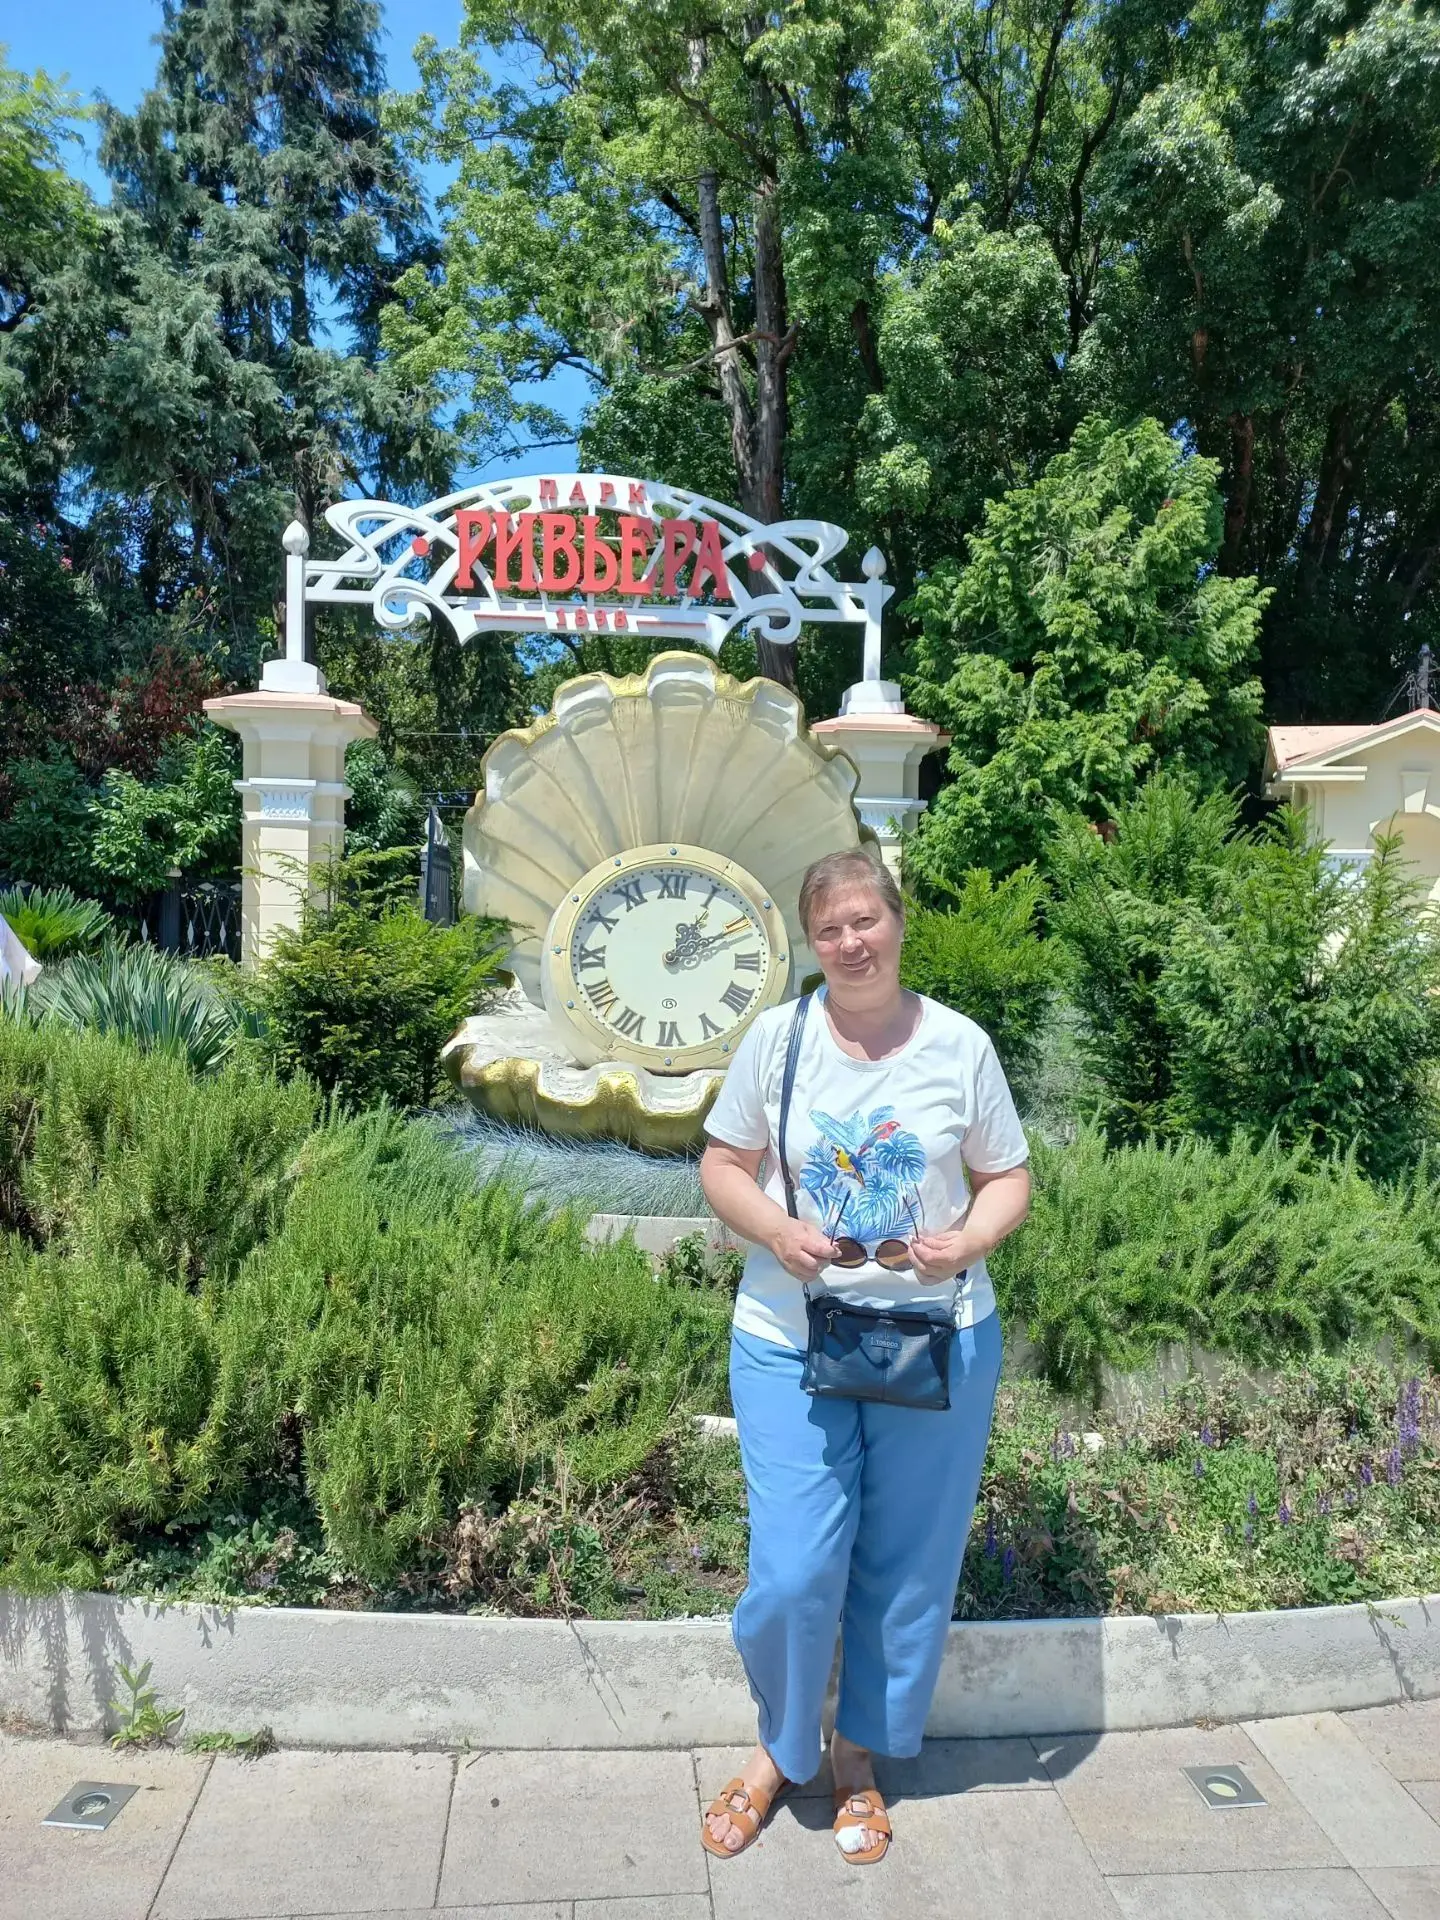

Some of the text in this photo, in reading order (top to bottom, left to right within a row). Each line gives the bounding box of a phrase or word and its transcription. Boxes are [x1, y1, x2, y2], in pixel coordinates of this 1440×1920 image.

[539, 479, 647, 505] ПАРК
[454, 509, 732, 599] РИВЬЕРА
[556, 607, 629, 629] 1898
[612, 879, 648, 913] XI
[653, 874, 692, 901] XII
[700, 884, 721, 909] I
[586, 906, 621, 935] X
[579, 943, 607, 972] IX
[734, 949, 761, 975] III
[583, 977, 620, 1018] VIII
[609, 1005, 646, 1043] VII
[656, 1021, 687, 1047] VI
[698, 1012, 724, 1041] V
